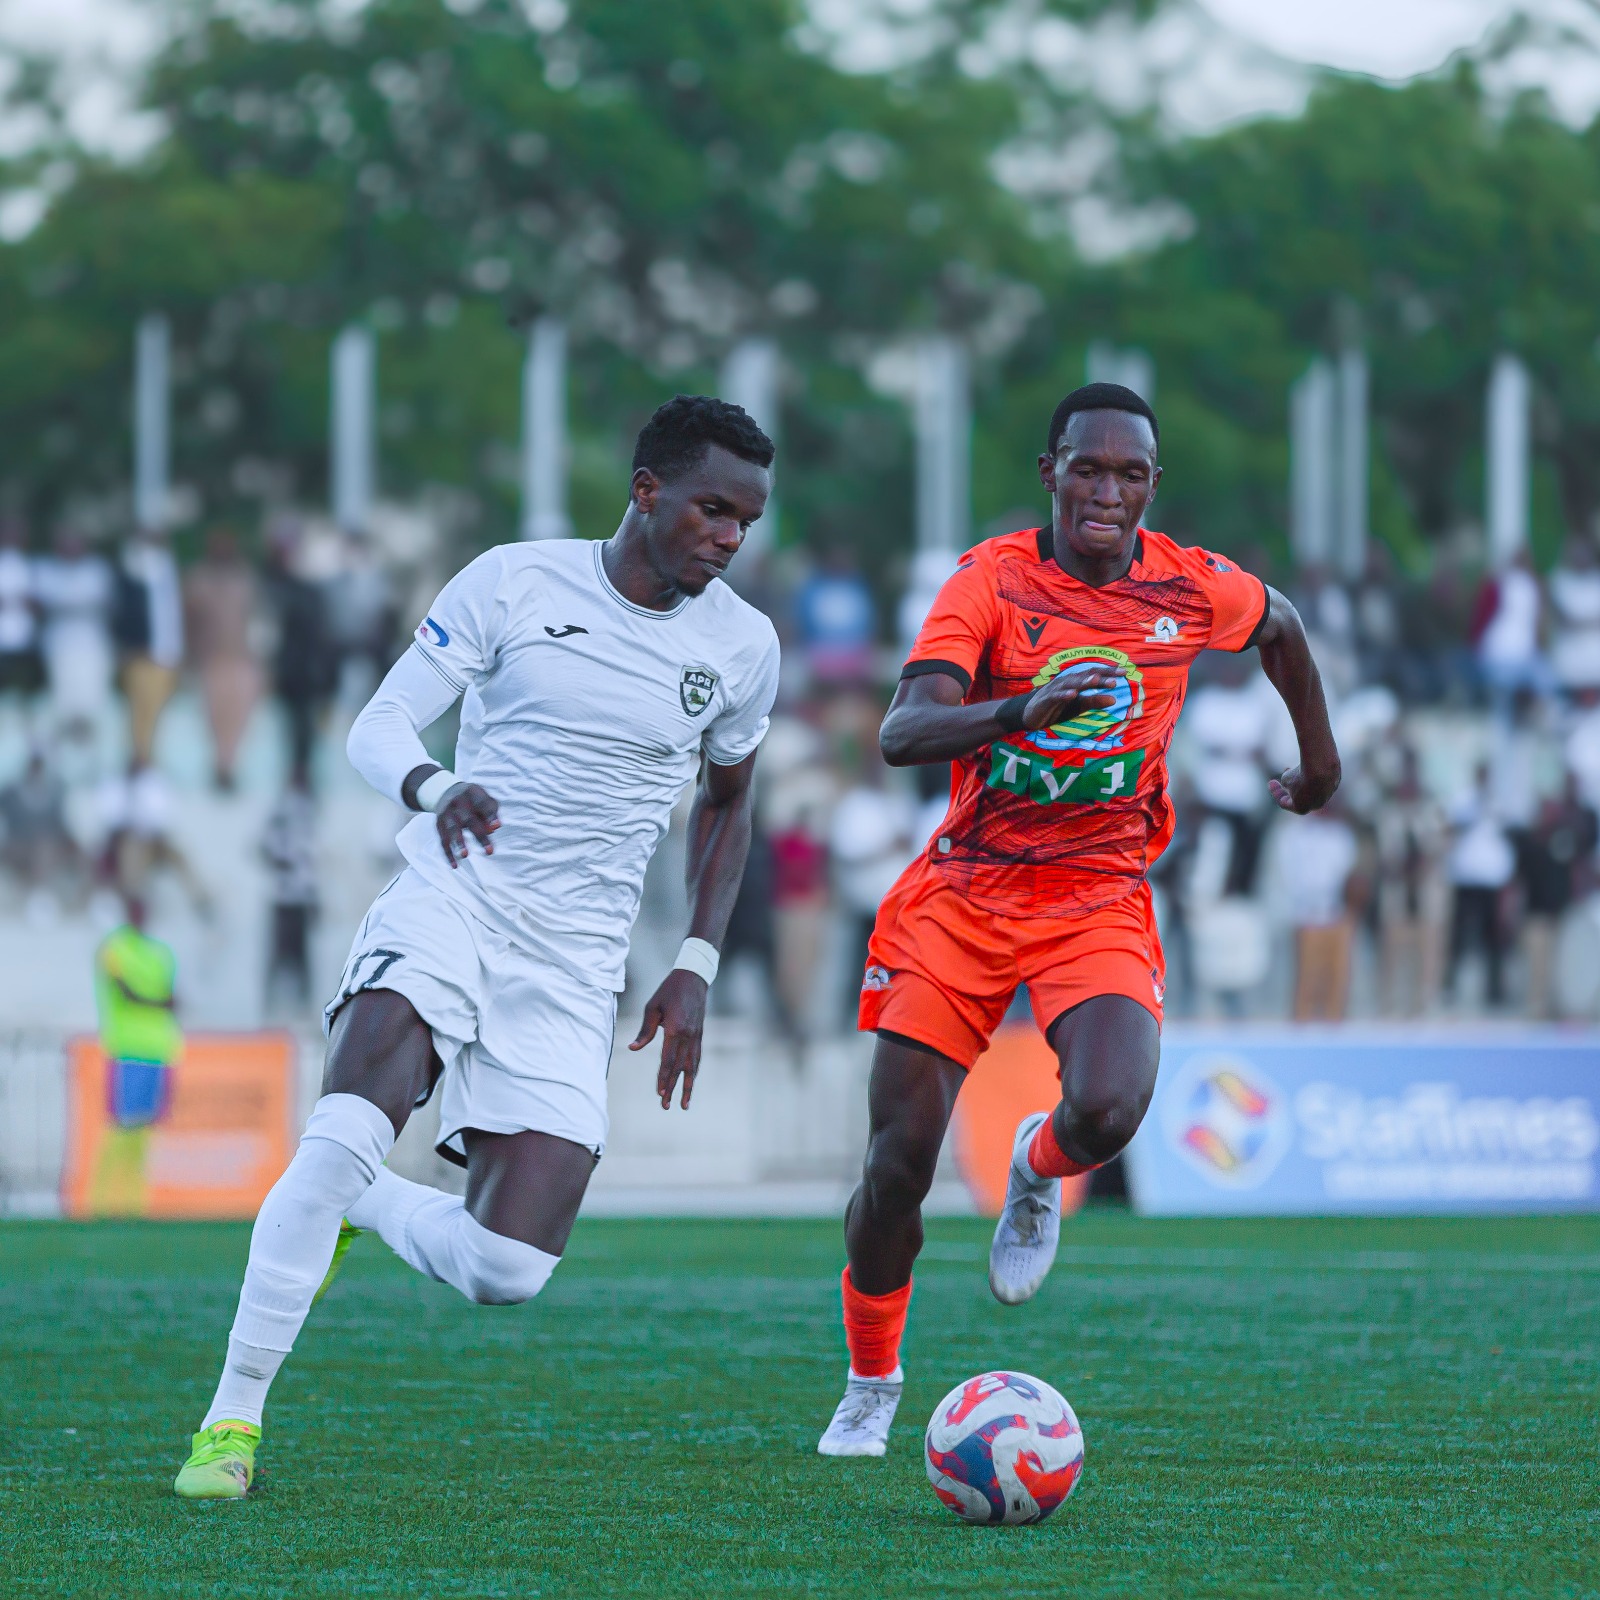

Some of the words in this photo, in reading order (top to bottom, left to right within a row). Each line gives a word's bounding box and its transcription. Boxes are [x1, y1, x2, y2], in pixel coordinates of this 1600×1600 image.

[1055, 649, 1084, 662] UMUJYI
[1098, 649, 1123, 660] KIGALI
[688, 673, 711, 687] APR
